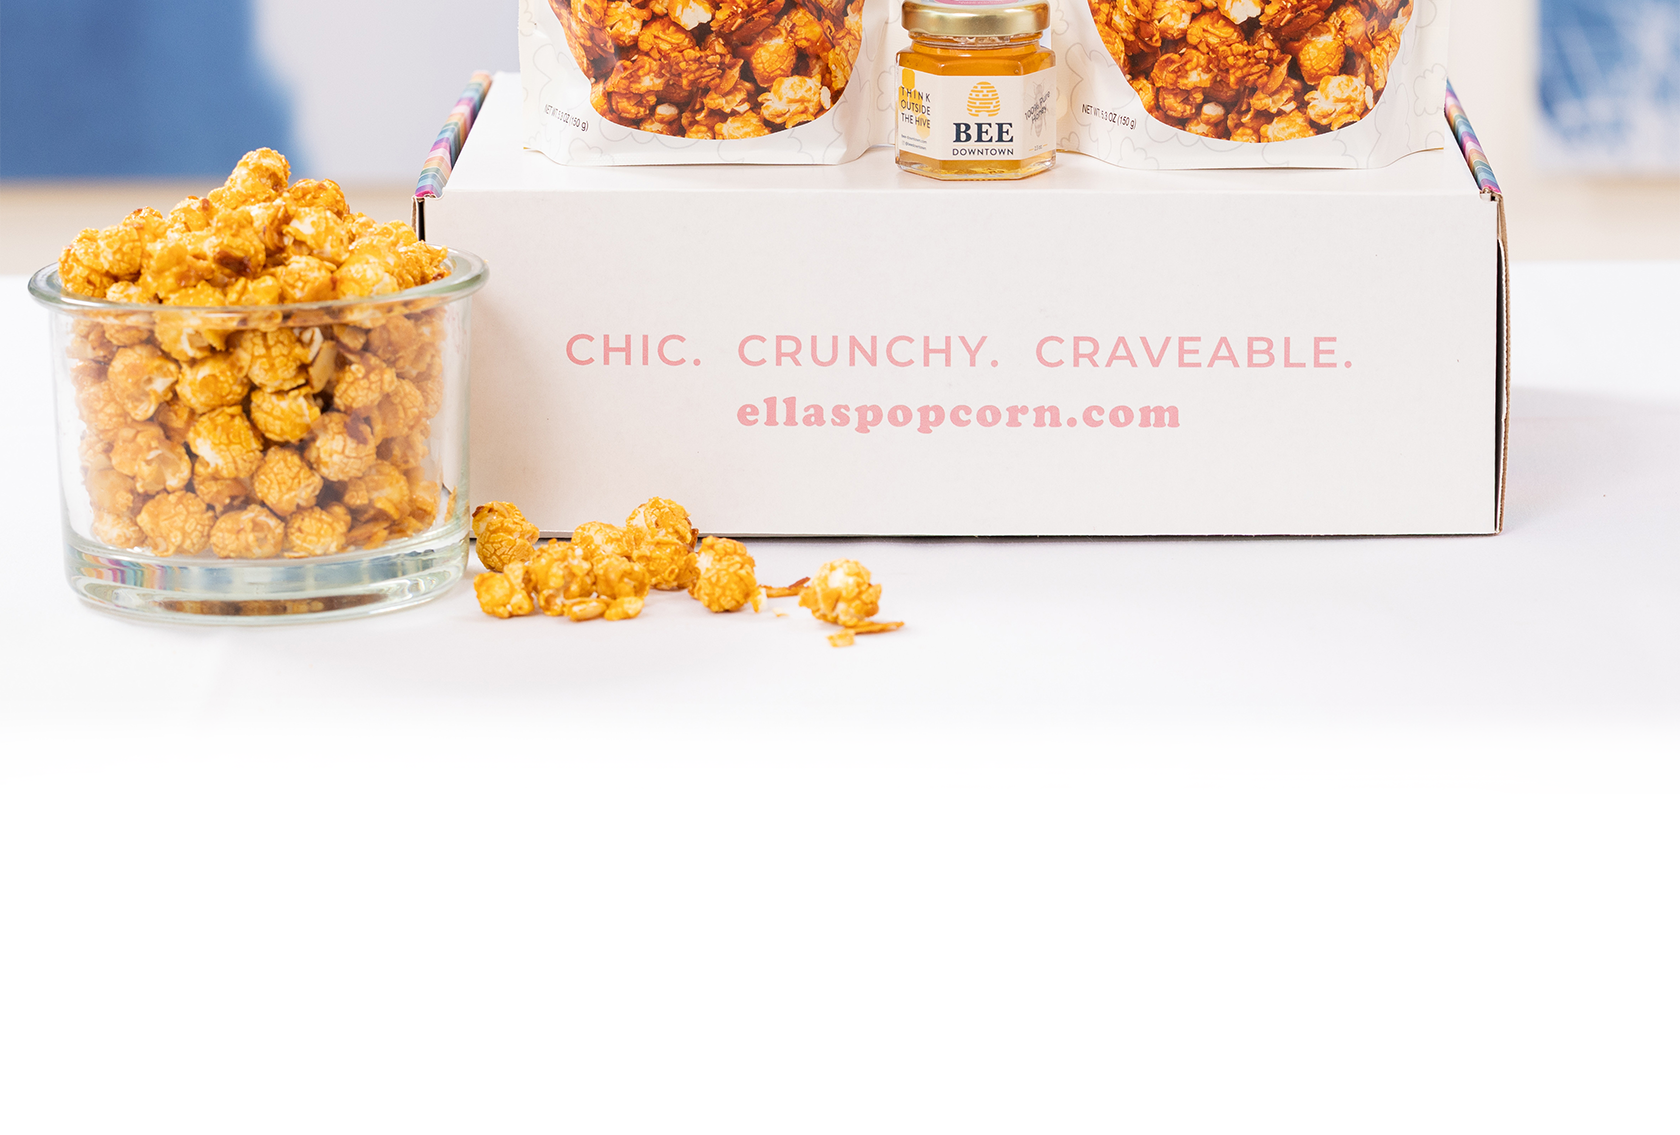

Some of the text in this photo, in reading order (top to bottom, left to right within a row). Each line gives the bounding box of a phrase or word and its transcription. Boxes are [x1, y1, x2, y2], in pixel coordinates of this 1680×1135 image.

[901, 86, 931, 103] THINK
[901, 99, 931, 116] OUTSIDE
[901, 113, 931, 129] THE HIVE
[1082, 104, 1093, 115] NET
[1108, 112, 1117, 123] OZ
[1117, 115, 1130, 126] (150
[1130, 118, 1137, 130] g)
[953, 122, 1014, 142] BEE
[953, 148, 1014, 156] DOWNTOWN
[566, 333, 1353, 369] CHIC. CRUNCHY. CRAVEABLE.
[737, 396, 1181, 434] ellaspopcorn.com
